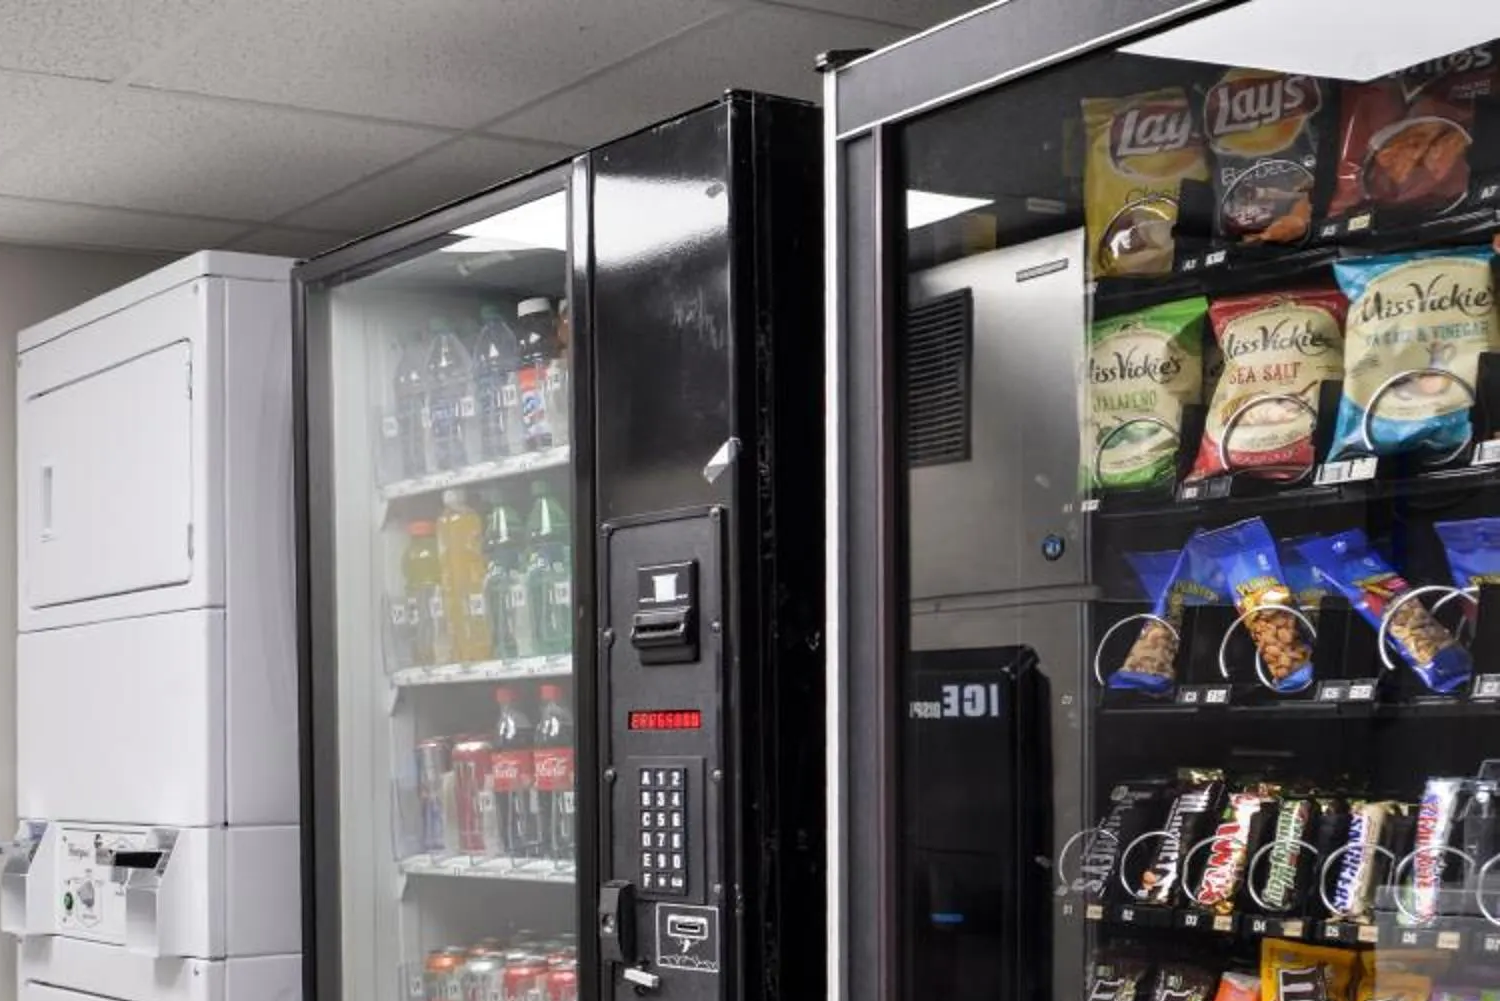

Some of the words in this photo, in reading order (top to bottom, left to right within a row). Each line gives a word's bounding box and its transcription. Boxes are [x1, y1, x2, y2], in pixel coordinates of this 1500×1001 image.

[641, 771, 651, 786] A
[657, 771, 665, 786] 1
[672, 771, 681, 786] 2
[657, 792, 665, 807] 3
[641, 812, 651, 827] C
[657, 812, 665, 827] 5
[657, 833, 665, 848] 7
[642, 854, 651, 869] E
